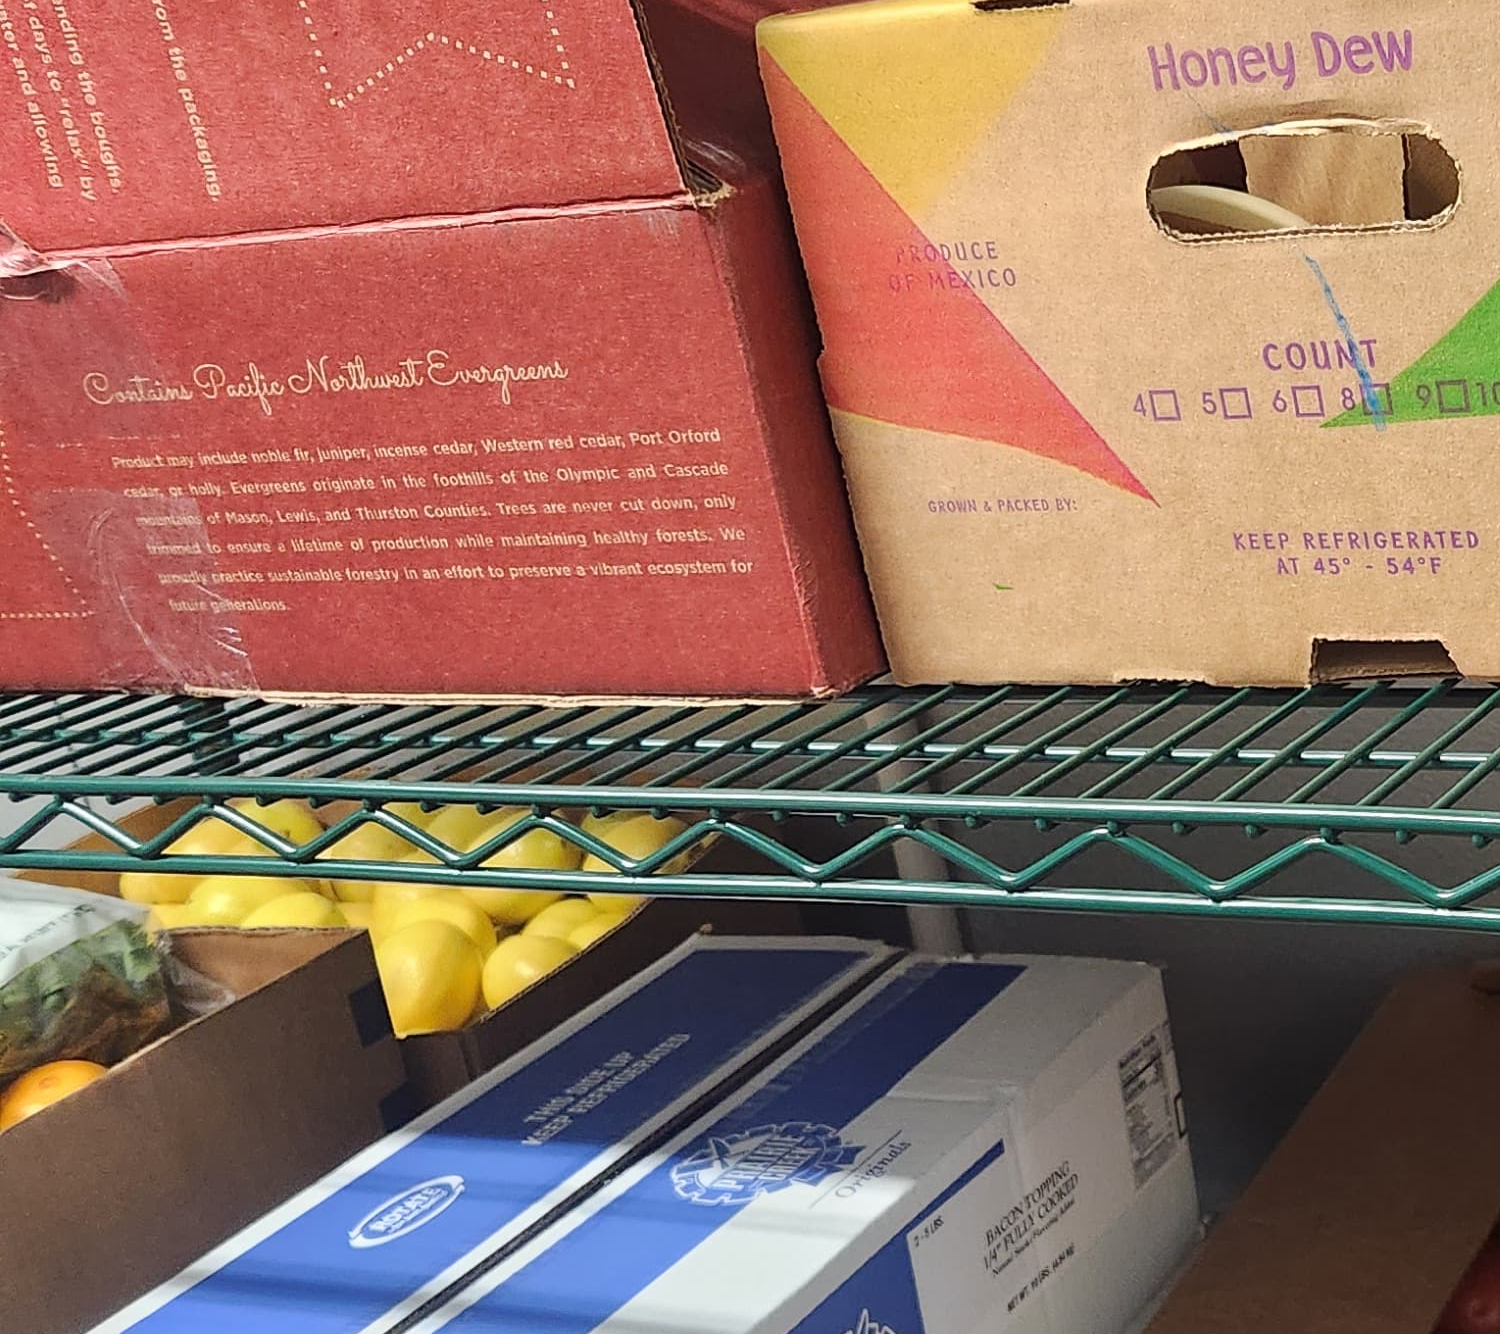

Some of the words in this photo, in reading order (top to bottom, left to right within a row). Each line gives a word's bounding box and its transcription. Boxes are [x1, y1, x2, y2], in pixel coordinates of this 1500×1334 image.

[168, 45, 191, 82] the
[1147, 39, 1295, 92] Honey
[1309, 30, 1415, 78] Dew
[12, 56, 37, 97] and
[27, 100, 64, 189] allowing
[28, 15, 52, 65] days
[46, 70, 64, 93] to
[79, 174, 97, 202] by
[77, 70, 97, 107] the
[89, 111, 122, 194] boughs,
[178, 87, 222, 202] packaging,
[895, 241, 999, 264] PRODUCE
[888, 273, 915, 293] OF
[929, 267, 1018, 291] MEXICO
[1261, 339, 1378, 372] COUNT
[82, 372, 193, 404] Contains
[192, 361, 285, 417] Pacific
[287, 354, 425, 395] Northwest
[426, 349, 569, 405] Evergreens
[1132, 393, 1148, 418] 4
[1201, 391, 1218, 415] 5
[1272, 389, 1287, 413] 6
[1341, 387, 1356, 411] 8
[1415, 384, 1432, 410] 9
[111, 454, 164, 469] Product
[166, 455, 195, 471] may
[197, 451, 248, 467] include
[251, 448, 291, 464] noble
[293, 448, 315, 464] fir,
[317, 445, 371, 466] juniper,
[373, 442, 429, 459] incense
[432, 439, 479, 457] cedar,
[481, 437, 544, 455] Western
[548, 434, 574, 450] red
[579, 432, 627, 450] cedar,
[628, 431, 664, 446] Port
[668, 428, 721, 444] Orford
[168, 486, 185, 499] or
[188, 482, 226, 499] holly.
[230, 479, 306, 498] Evergreens
[312, 476, 375, 494] originate
[381, 475, 396, 490] in
[403, 474, 427, 489] the
[433, 472, 494, 488] foothills
[501, 469, 517, 485] of
[523, 468, 549, 484] the
[556, 465, 620, 485] Olympic
[626, 463, 657, 480] and
[663, 461, 729, 478] Cascade
[928, 498, 977, 514] GROWN
[983, 498, 993, 513] &
[998, 497, 1050, 513] PACKED
[1056, 497, 1078, 512] BY:
[1232, 531, 1290, 551] KEEP
[1302, 530, 1480, 551] REFRIGERATED
[1277, 557, 1300, 575] AT
[1313, 556, 1351, 576] 45°
[1386, 555, 1443, 575] 54°F
[835, 1140, 911, 1198] Originals
[372, 1186, 441, 1232] ROTATE
[986, 1199, 1023, 1244] BACON
[1025, 1161, 1070, 1208] TOPPING
[1004, 1213, 1035, 1253] FULLY
[1037, 1174, 1078, 1218] COOKED
